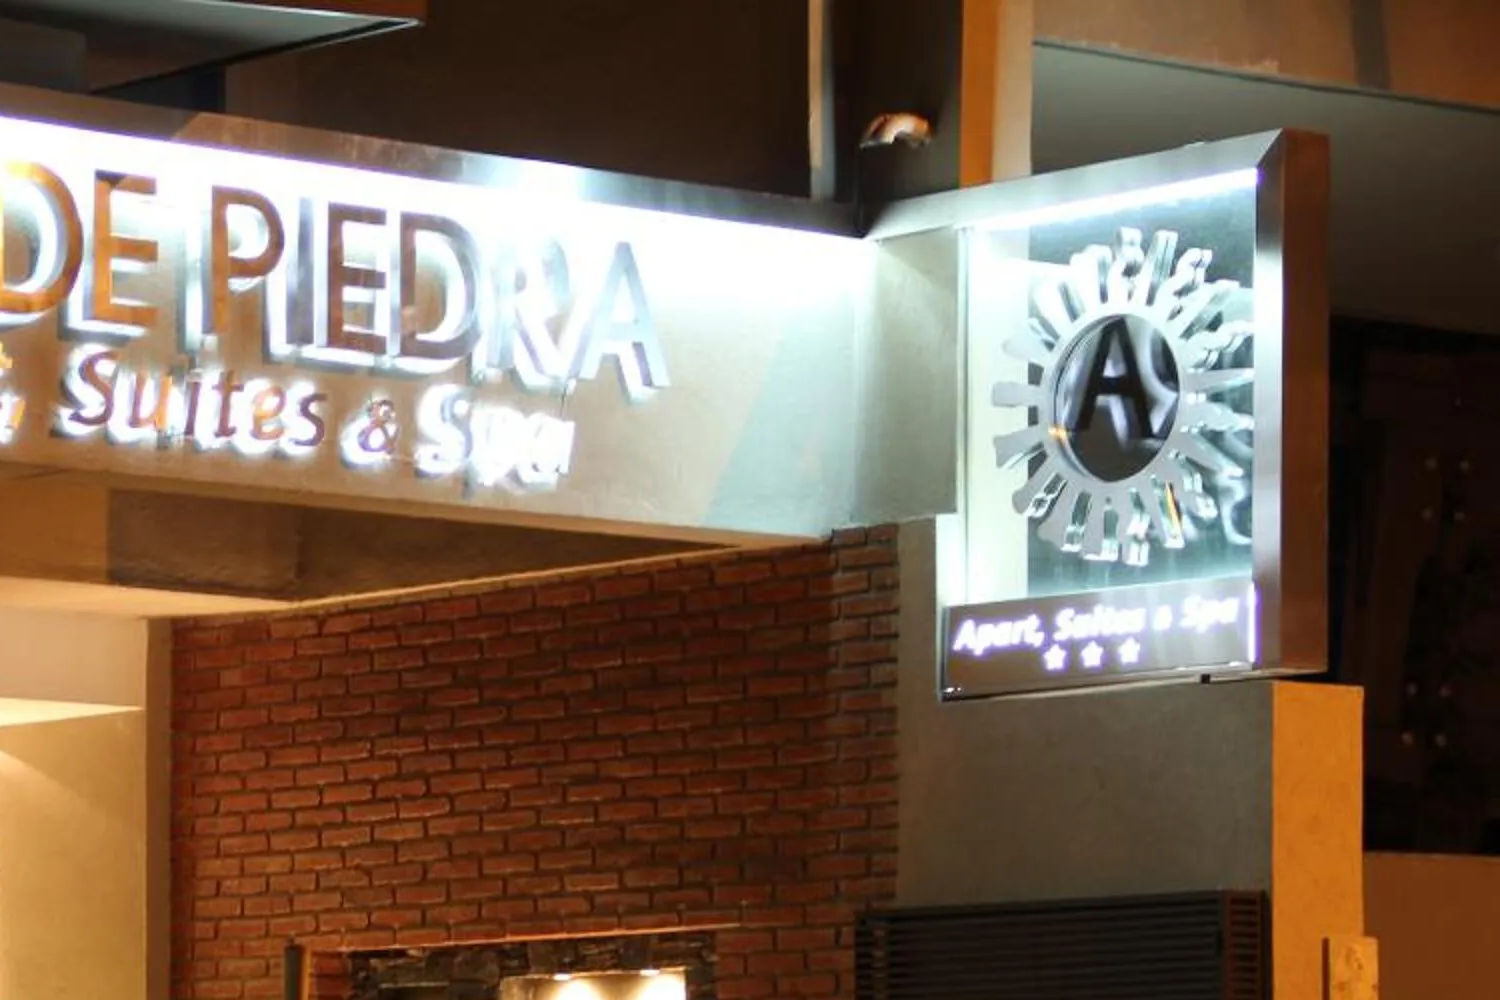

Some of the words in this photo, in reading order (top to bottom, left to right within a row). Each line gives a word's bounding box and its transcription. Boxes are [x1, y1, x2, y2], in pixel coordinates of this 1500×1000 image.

[208, 184, 670, 390] PIEDRA
[66, 349, 327, 448] Suites
[350, 398, 398, 458] &
